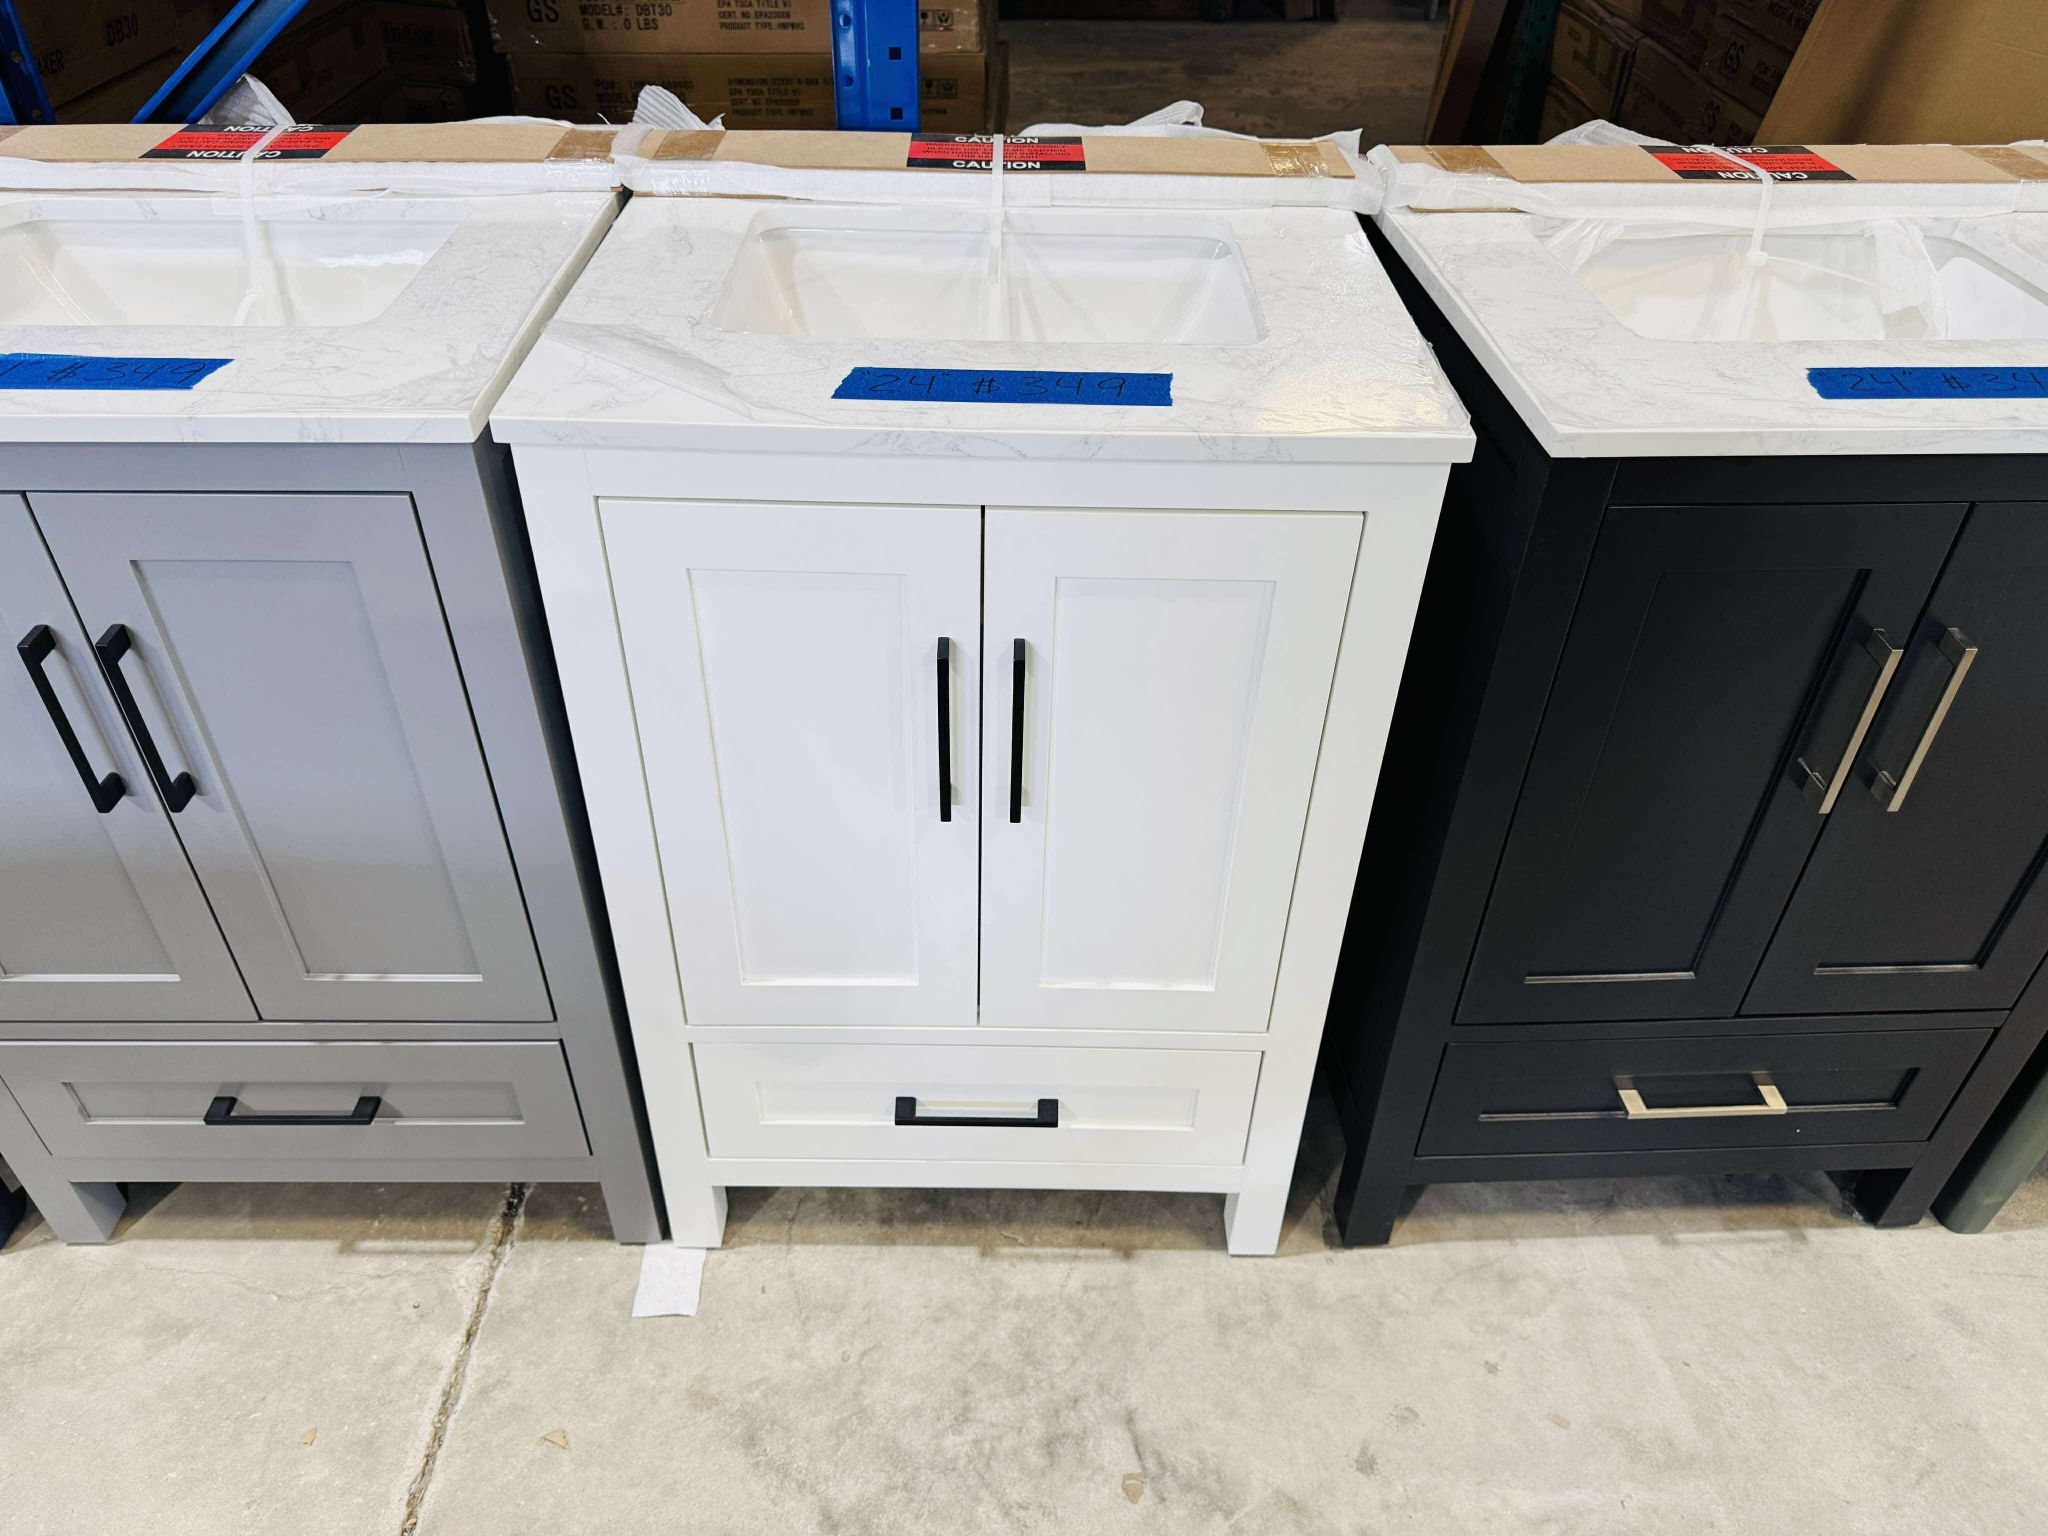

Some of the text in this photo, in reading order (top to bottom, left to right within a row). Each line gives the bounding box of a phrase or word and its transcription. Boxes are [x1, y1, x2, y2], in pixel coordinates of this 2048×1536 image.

[635, 18, 659, 30] LBS
[545, 84, 577, 110] GS
[954, 136, 1039, 144] CAUION
[952, 160, 1041, 170] CAUION
